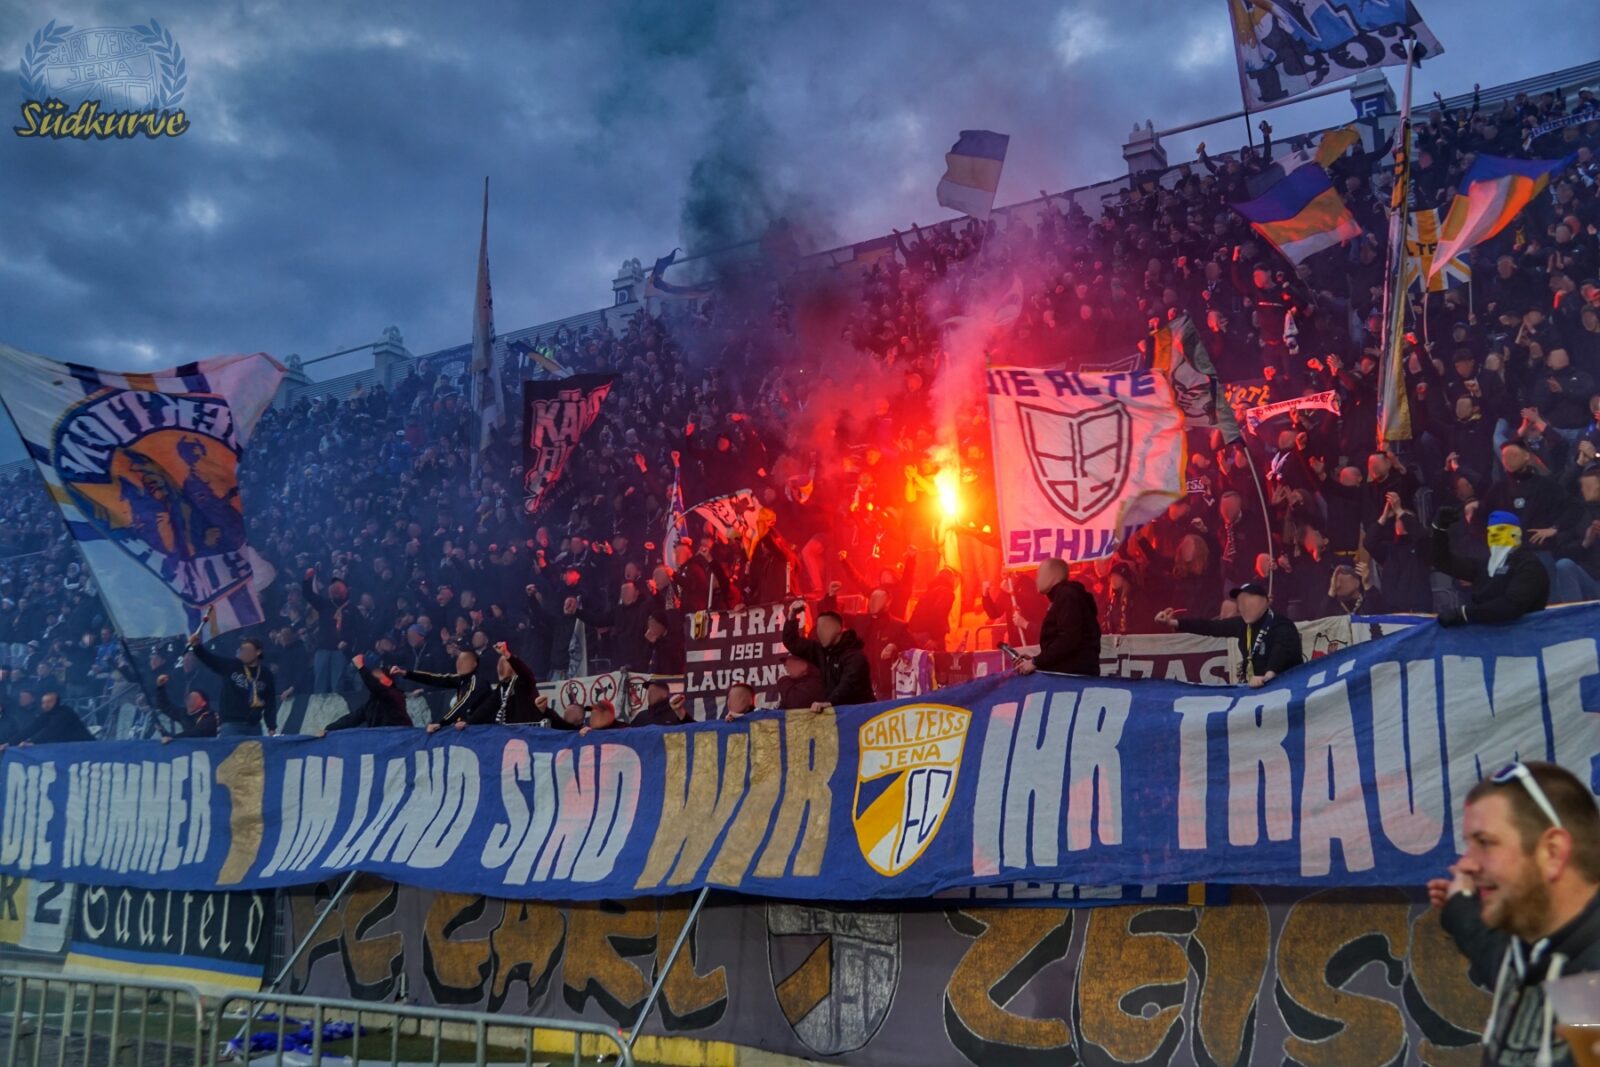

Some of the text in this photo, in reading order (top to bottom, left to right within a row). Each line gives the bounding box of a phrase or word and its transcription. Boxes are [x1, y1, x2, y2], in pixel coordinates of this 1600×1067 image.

[1044, 368, 1156, 398] ALTE
[686, 604, 806, 640] ULTRA
[730, 642, 764, 660] 1993
[864, 710, 966, 746] CARL ZEISS
[879, 743, 942, 771] JENA
[1, 761, 57, 871] DIE
[62, 750, 211, 874] NUMMER
[215, 740, 264, 885] 1
[259, 754, 344, 878] IM
[321, 745, 481, 869] LAND
[480, 739, 643, 886] SIND
[633, 707, 840, 889] WIR
[972, 687, 1132, 877] IHR
[896, 768, 953, 864] FC
[83, 884, 265, 956] Saalfeld
[801, 909, 865, 935] JENA
